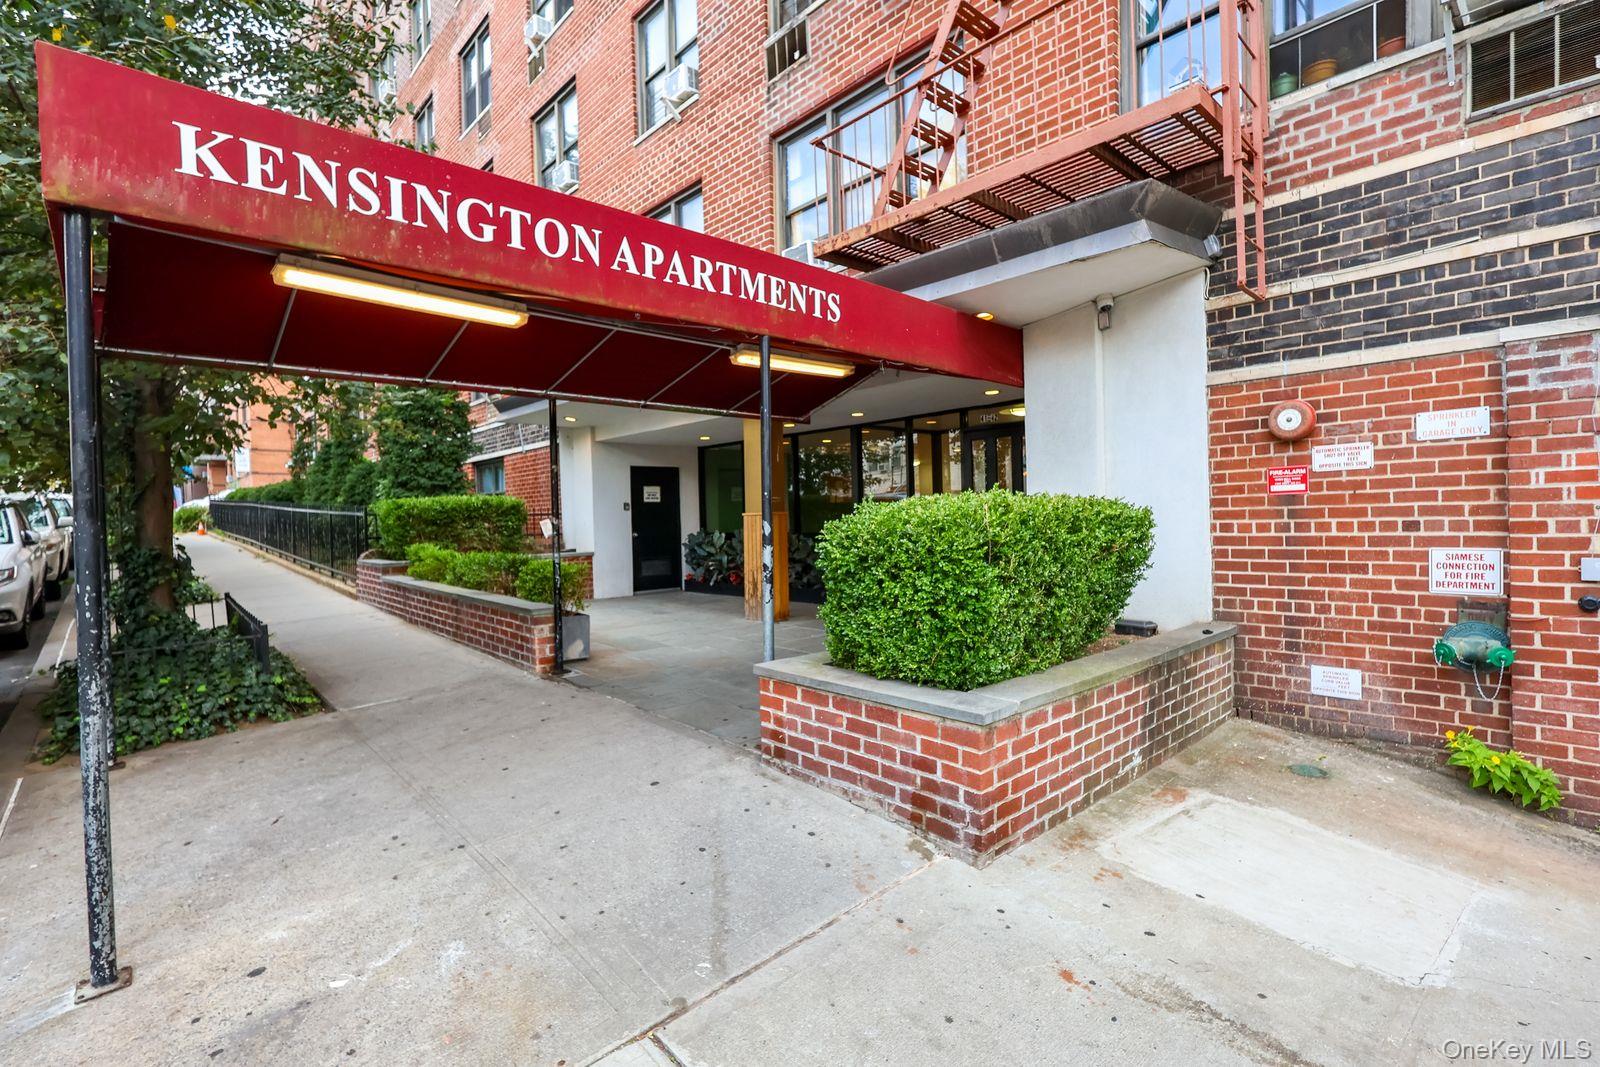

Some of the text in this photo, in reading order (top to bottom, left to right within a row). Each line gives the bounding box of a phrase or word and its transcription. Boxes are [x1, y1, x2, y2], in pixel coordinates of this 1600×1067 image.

[172, 121, 843, 323] KENSINGTON APARTMENTS
[1428, 411, 1477, 421] SPRINKLER
[1423, 426, 1483, 438] GARAGE ONLY
[1445, 553, 1486, 562] SIAMESE
[1436, 562, 1495, 571] CONNECTION
[1444, 571, 1486, 580] FOR FIRE
[1435, 580, 1496, 590] DEPARTMENT
